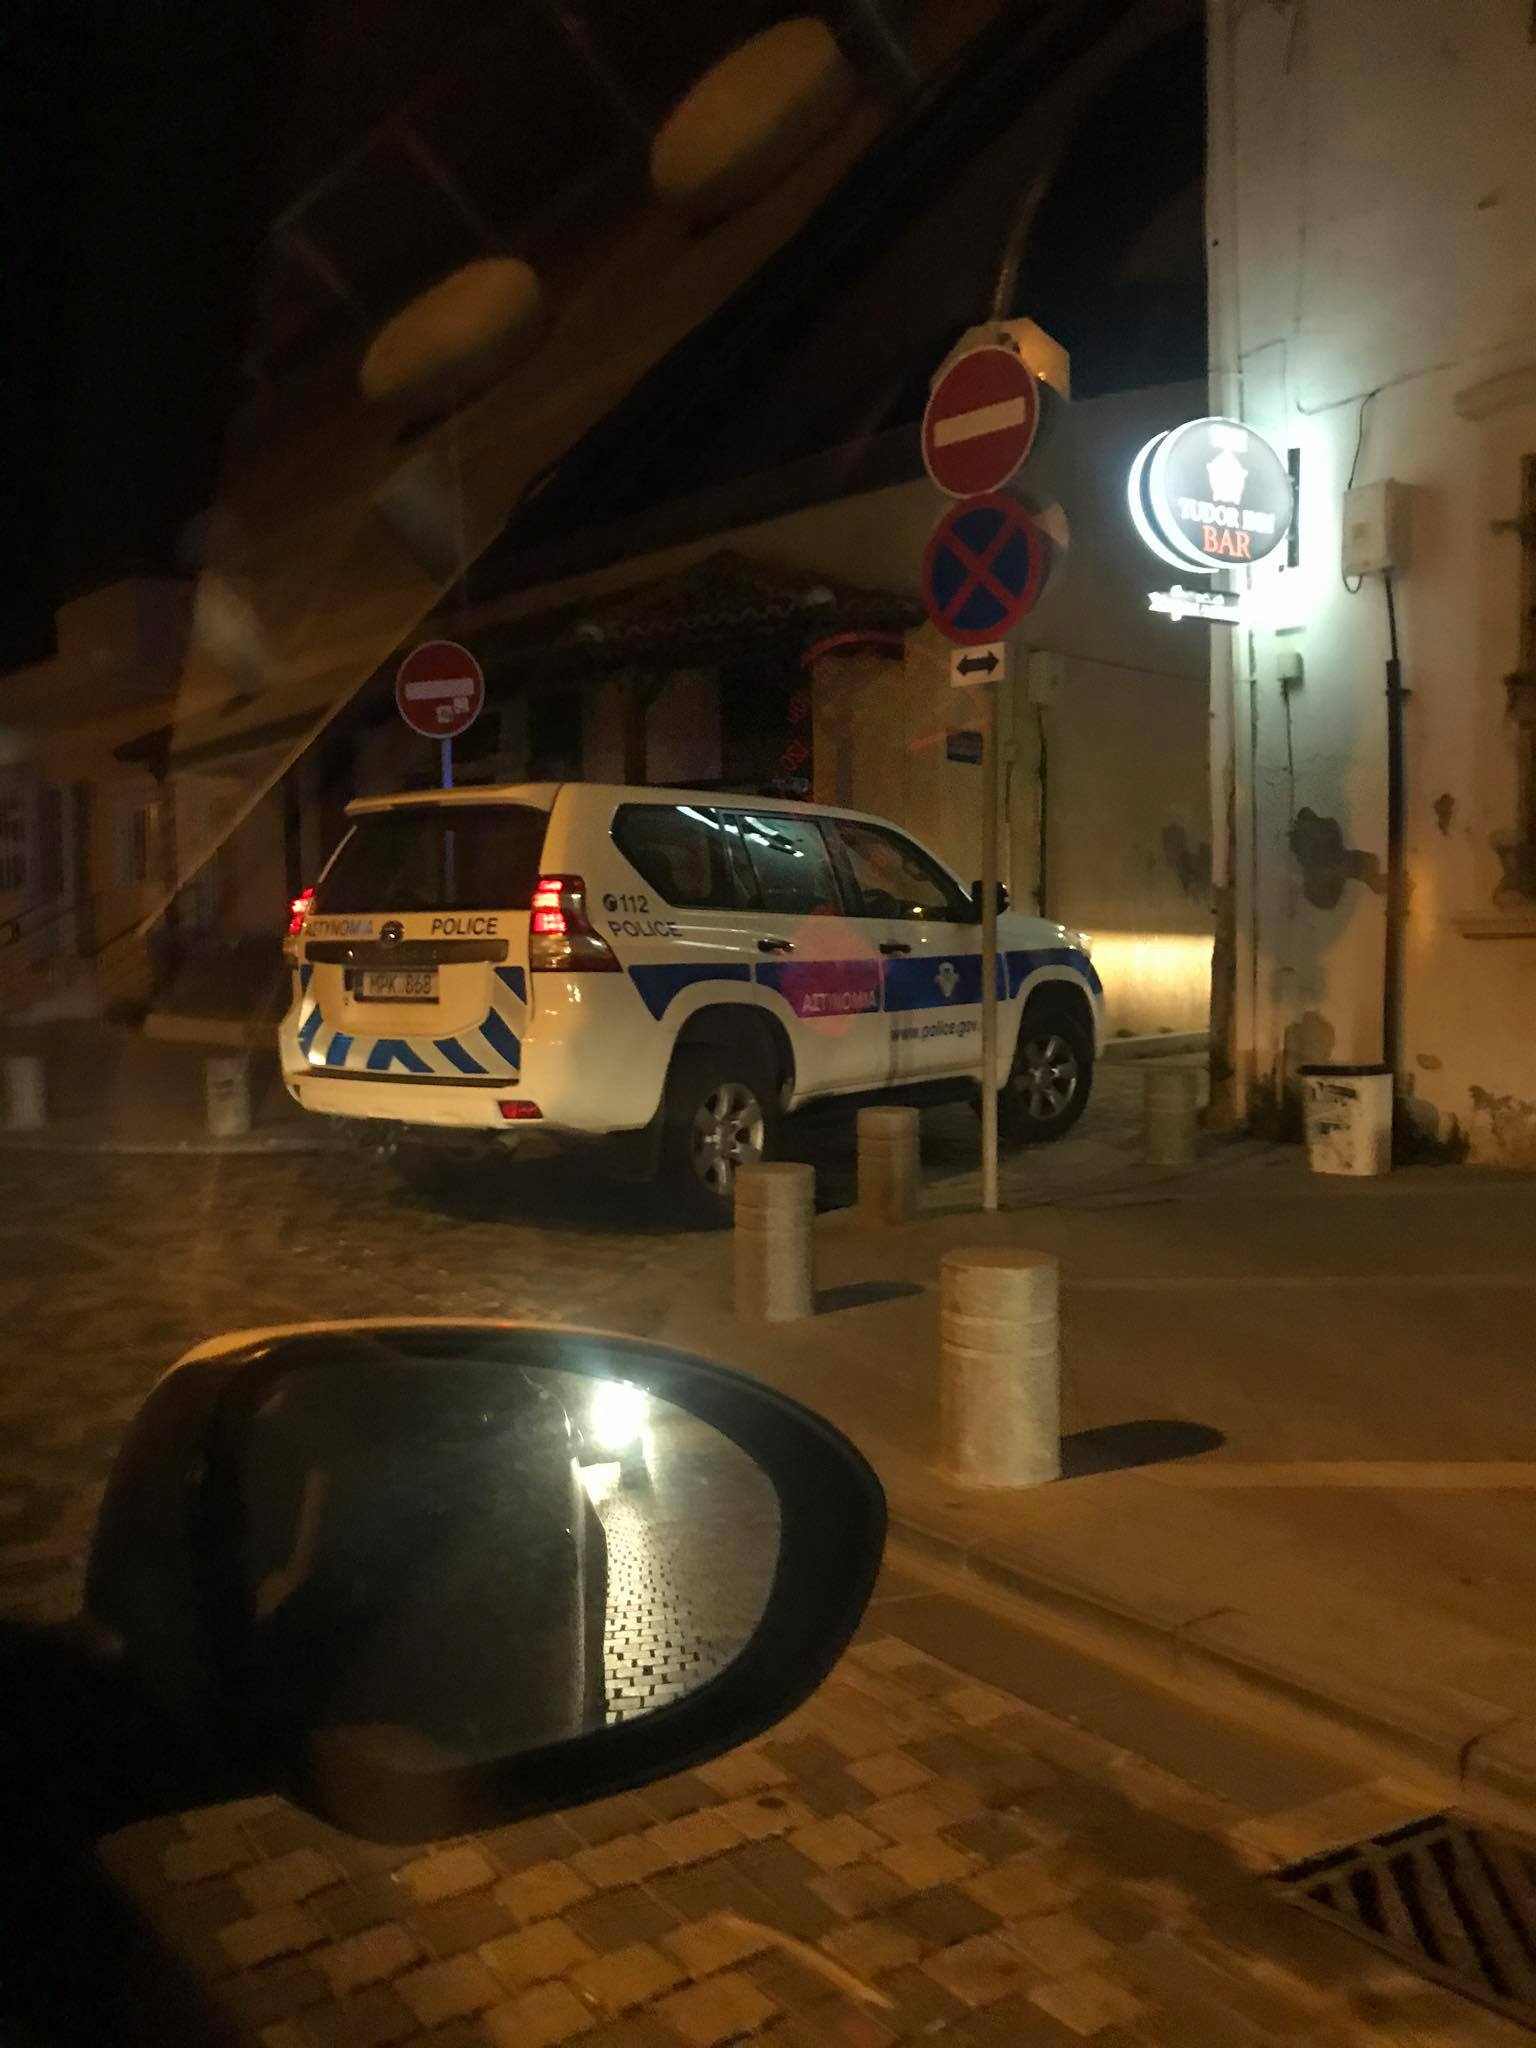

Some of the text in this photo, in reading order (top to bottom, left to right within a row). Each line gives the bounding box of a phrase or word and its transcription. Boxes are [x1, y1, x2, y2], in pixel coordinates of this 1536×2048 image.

[1177, 496, 1240, 528] TUDOR
[1201, 524, 1251, 560] BAR
[619, 894, 650, 913] 112
[432, 917, 499, 936] POLICE
[607, 920, 684, 937] POLICE
[890, 1019, 978, 1041] www.police.gov
